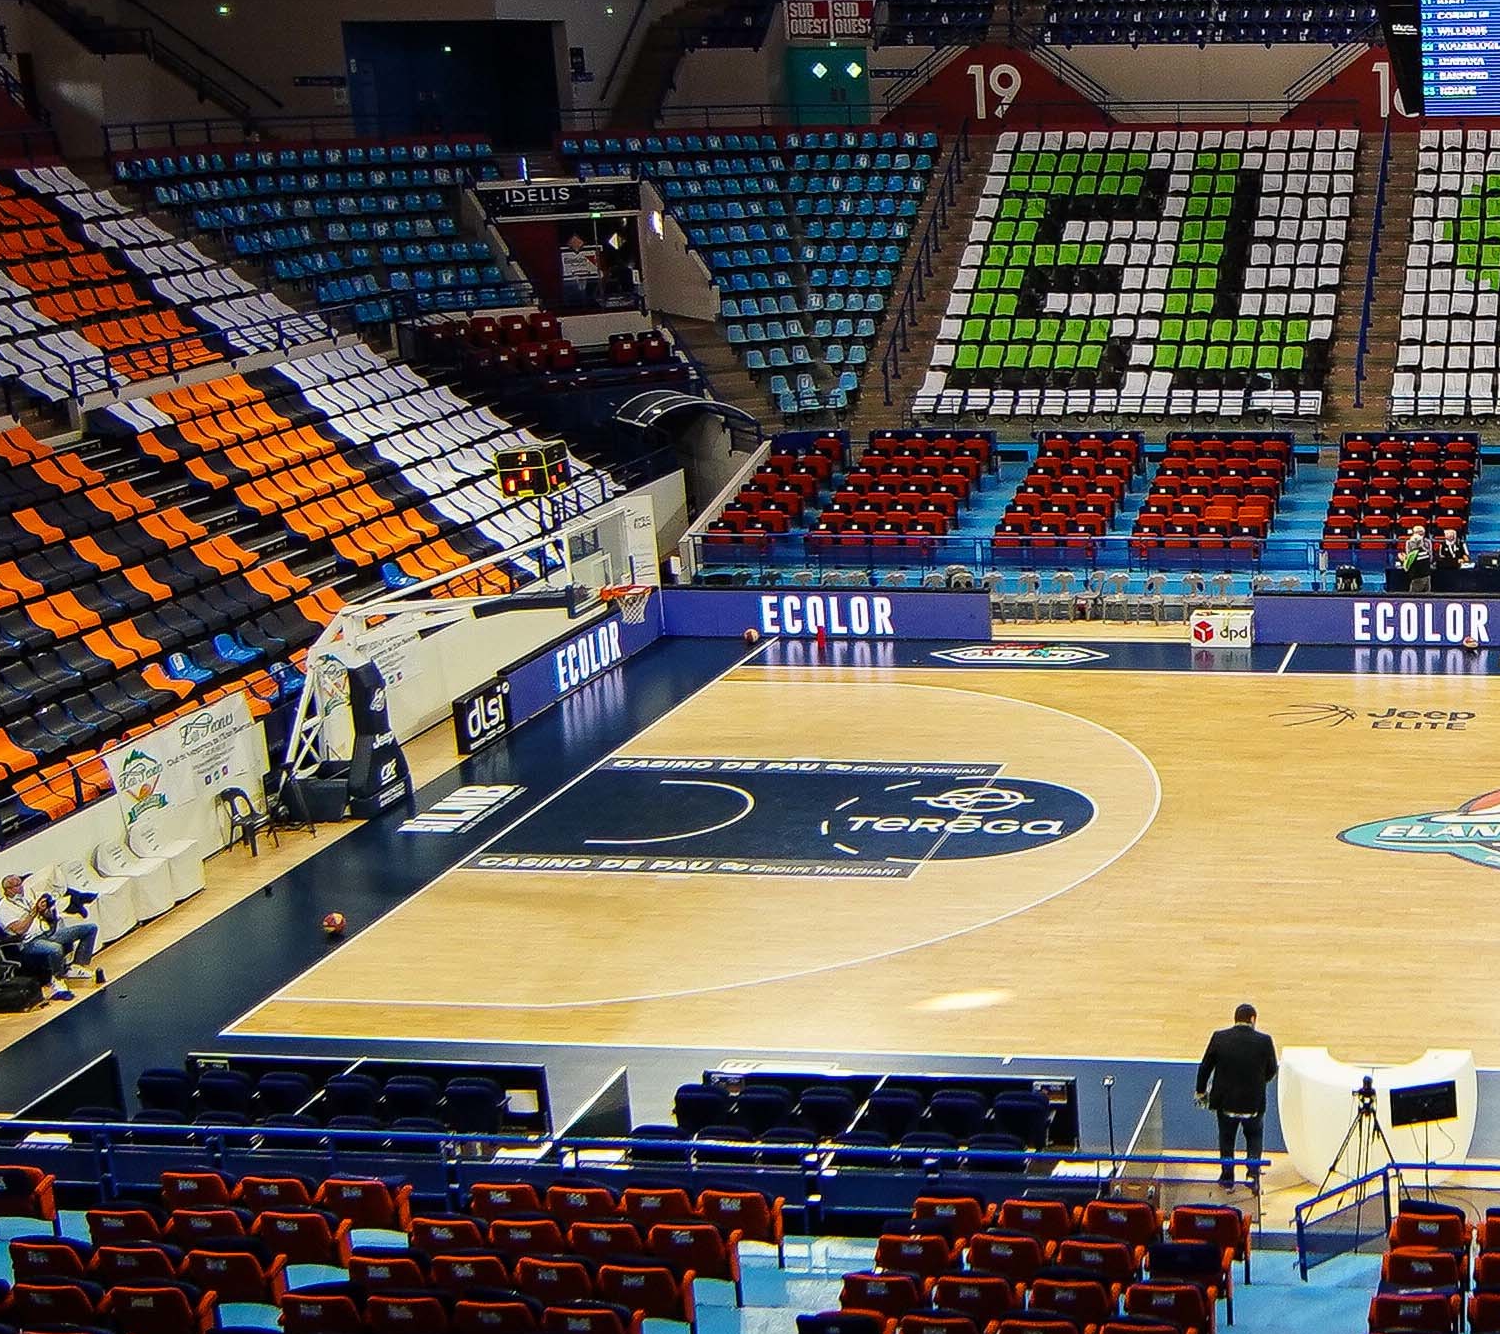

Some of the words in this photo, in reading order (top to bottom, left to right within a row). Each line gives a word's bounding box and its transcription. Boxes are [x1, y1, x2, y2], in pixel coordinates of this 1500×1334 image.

[788, 2, 815, 18] SUD
[833, 1, 860, 18] SUD
[790, 18, 829, 35] OUEST
[966, 63, 1022, 121] 19
[504, 187, 571, 205] IDELIS
[760, 593, 896, 637] ECOLOR
[1352, 600, 1491, 643] ECOLOR
[1218, 623, 1249, 643] dpd
[556, 620, 622, 694] ECOLOR
[466, 679, 505, 740] dlsi
[1367, 707, 1477, 723] Jeep
[372, 729, 395, 750] Jeep
[611, 758, 714, 770] CASINO
[718, 760, 762, 771] DE
[763, 761, 828, 773] PAU
[477, 856, 591, 869] CASINO
[601, 858, 646, 870] DE
[648, 859, 715, 872] PAU
